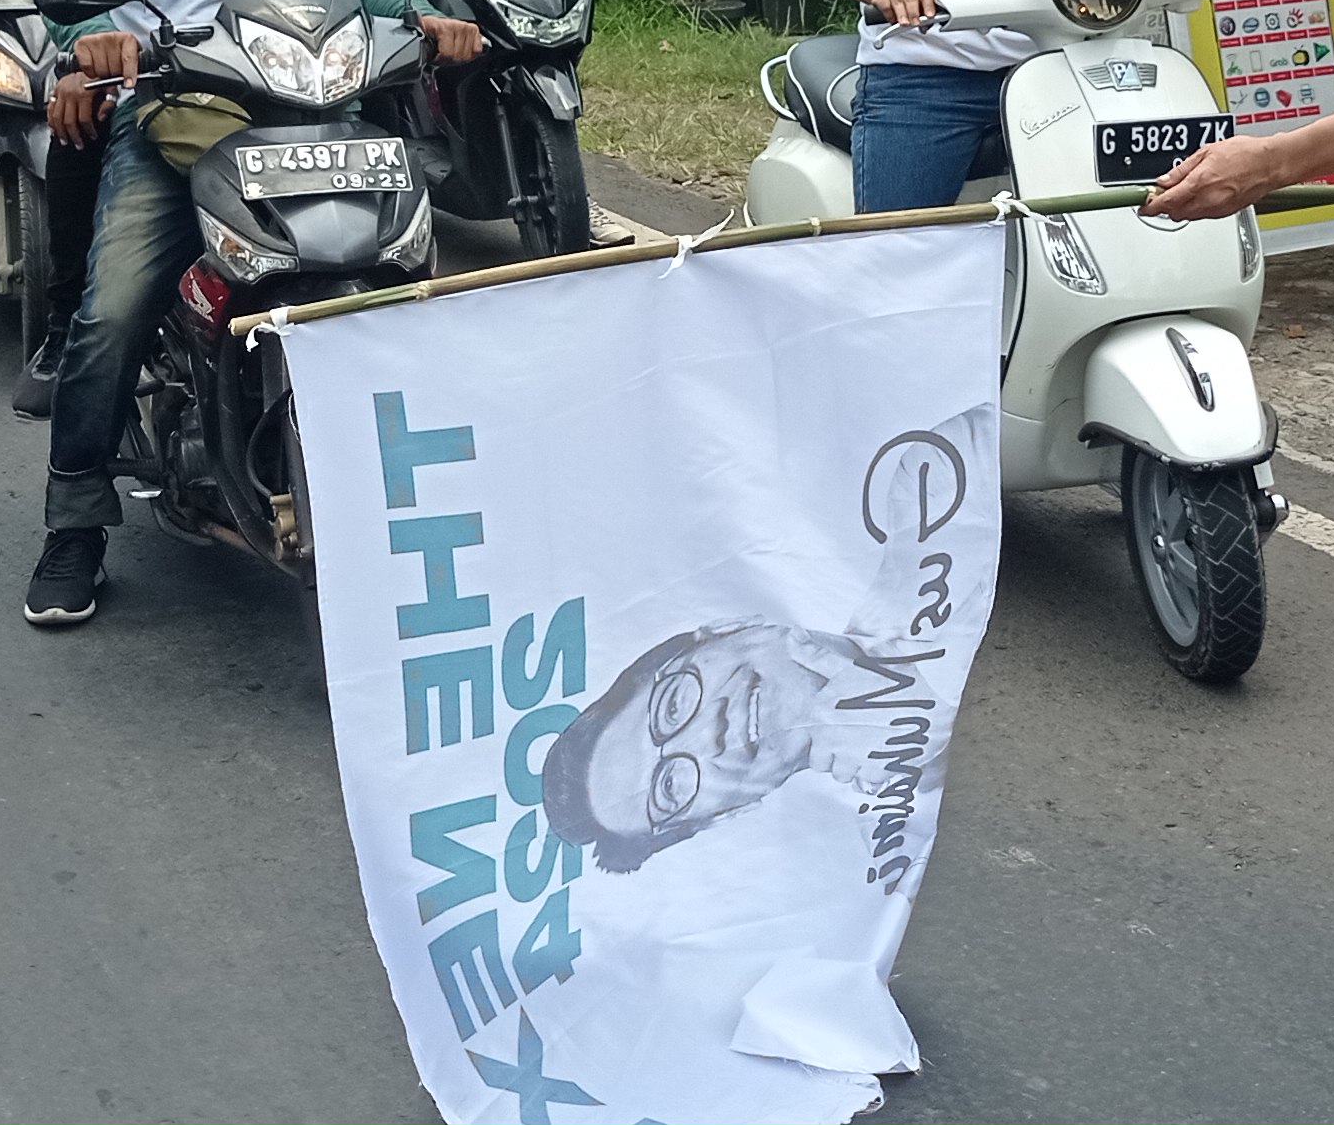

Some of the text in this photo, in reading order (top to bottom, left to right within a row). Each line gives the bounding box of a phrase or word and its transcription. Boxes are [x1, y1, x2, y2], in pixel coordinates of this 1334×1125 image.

[1101, 121, 1230, 155] G 5823 ZK
[245, 141, 402, 174] G 4597 PK
